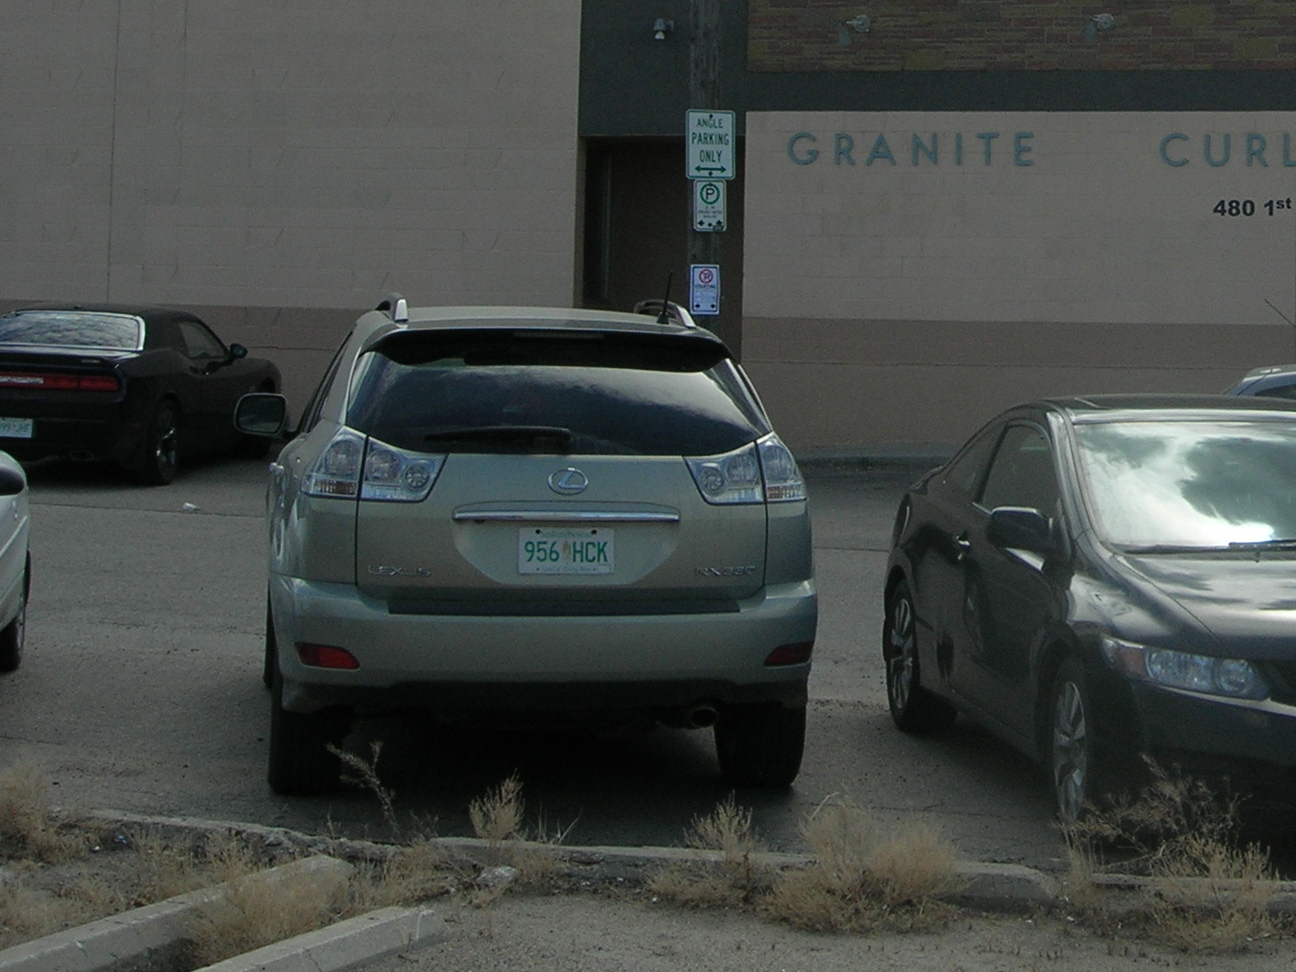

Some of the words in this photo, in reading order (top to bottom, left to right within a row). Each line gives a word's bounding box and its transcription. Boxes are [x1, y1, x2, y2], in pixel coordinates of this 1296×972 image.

[696, 118, 724, 129] ANGLE
[691, 132, 730, 146] PARKING
[699, 149, 723, 163] ONLY
[787, 131, 1034, 167] GRANITE
[1213, 199, 1255, 217] 480
[1264, 197, 1292, 217] 1st
[524, 540, 560, 563] 956
[572, 540, 609, 563] HCK
